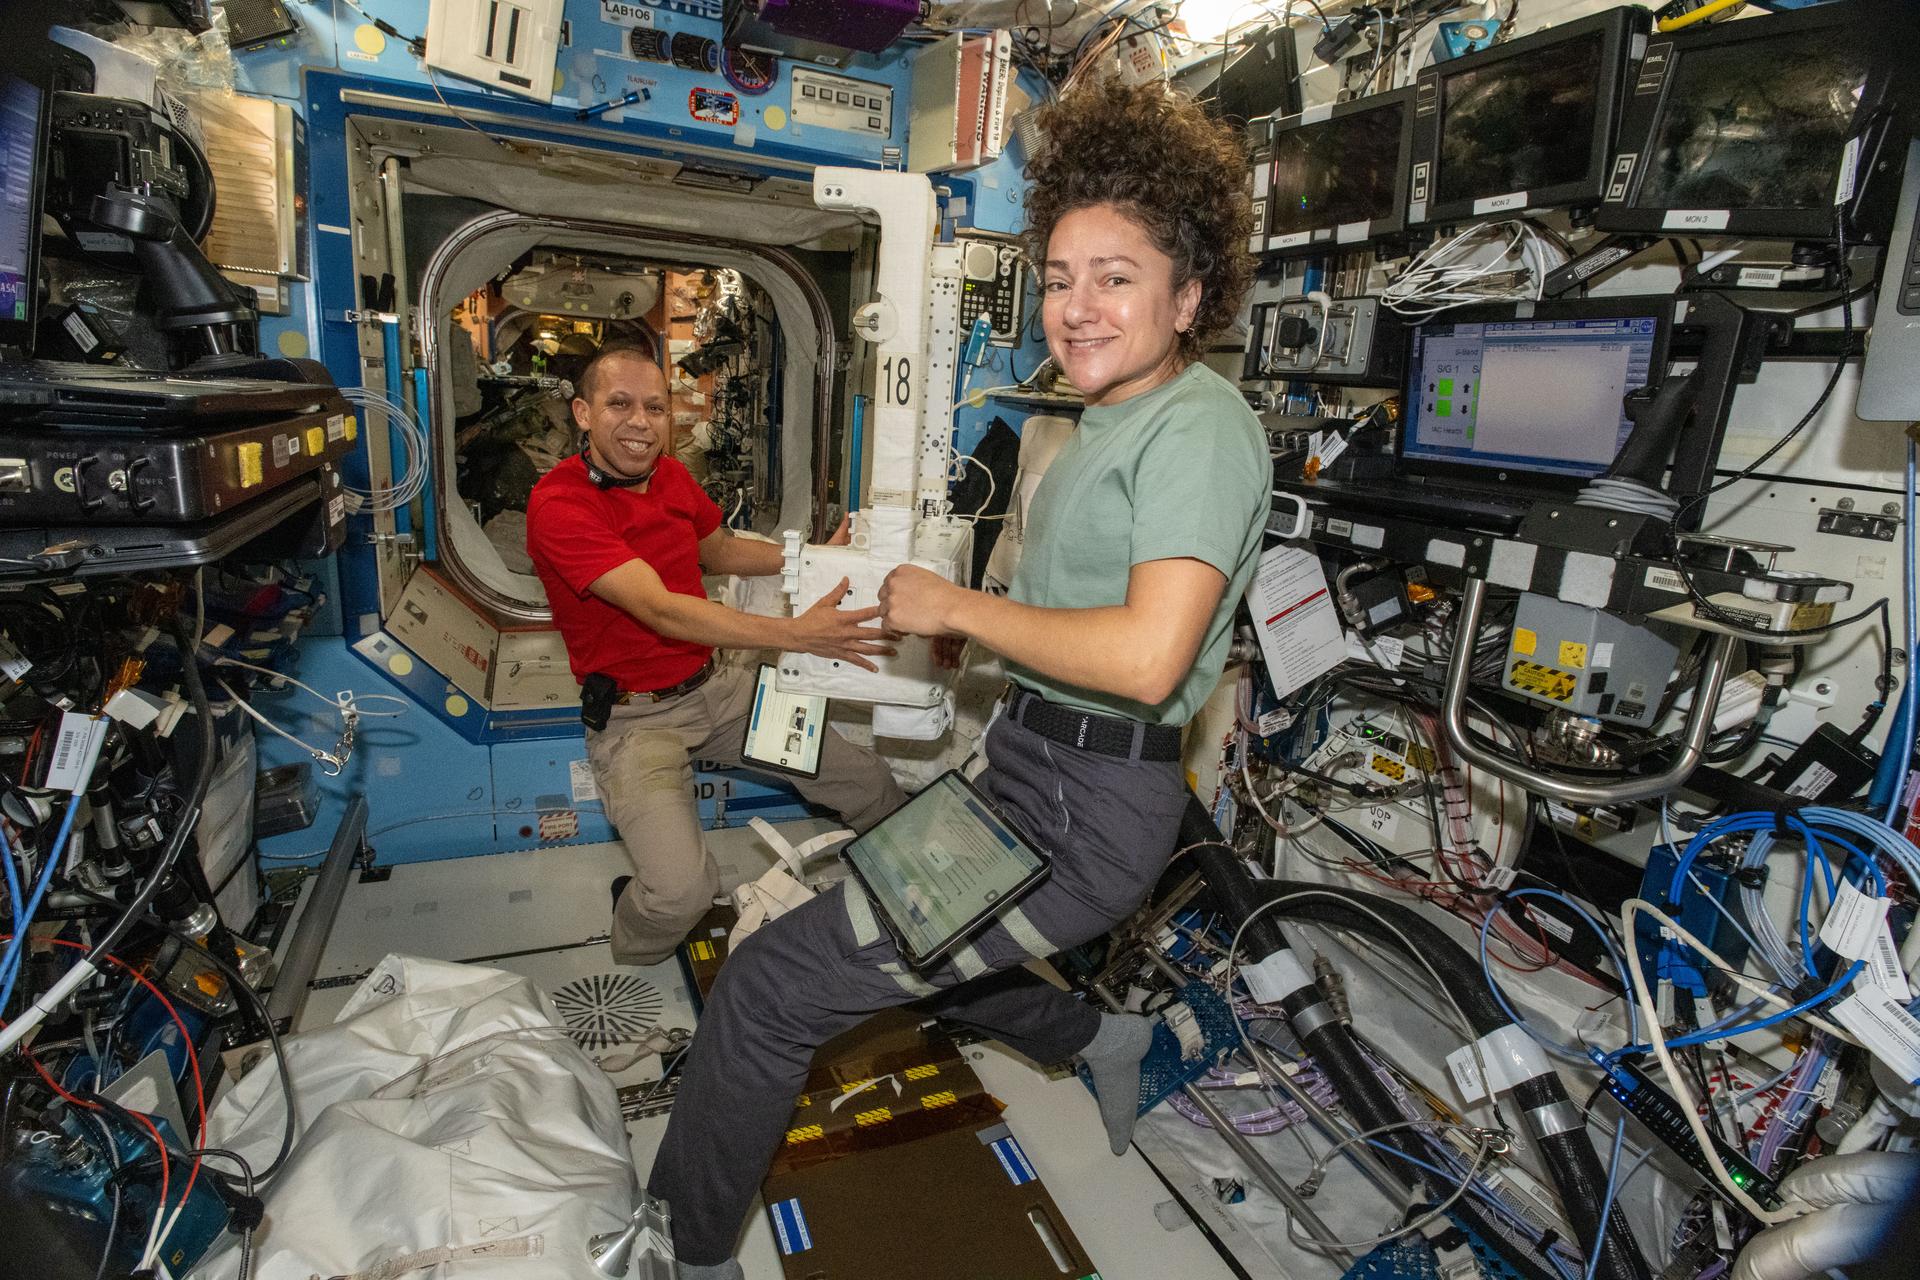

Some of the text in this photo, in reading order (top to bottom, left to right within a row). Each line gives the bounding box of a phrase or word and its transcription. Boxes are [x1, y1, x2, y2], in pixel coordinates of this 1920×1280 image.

[604, 2, 650, 20] LAB106
[976, 72, 989, 141] WARNING
[1685, 215, 1708, 223] MON 3
[1436, 364, 1452, 374] S/G
[883, 356, 910, 406] 18
[46, 451, 78, 459] POWER
[1524, 668, 1546, 678] CAUTION
[722, 780, 730, 798] 1
[1372, 820, 1383, 830] #7
